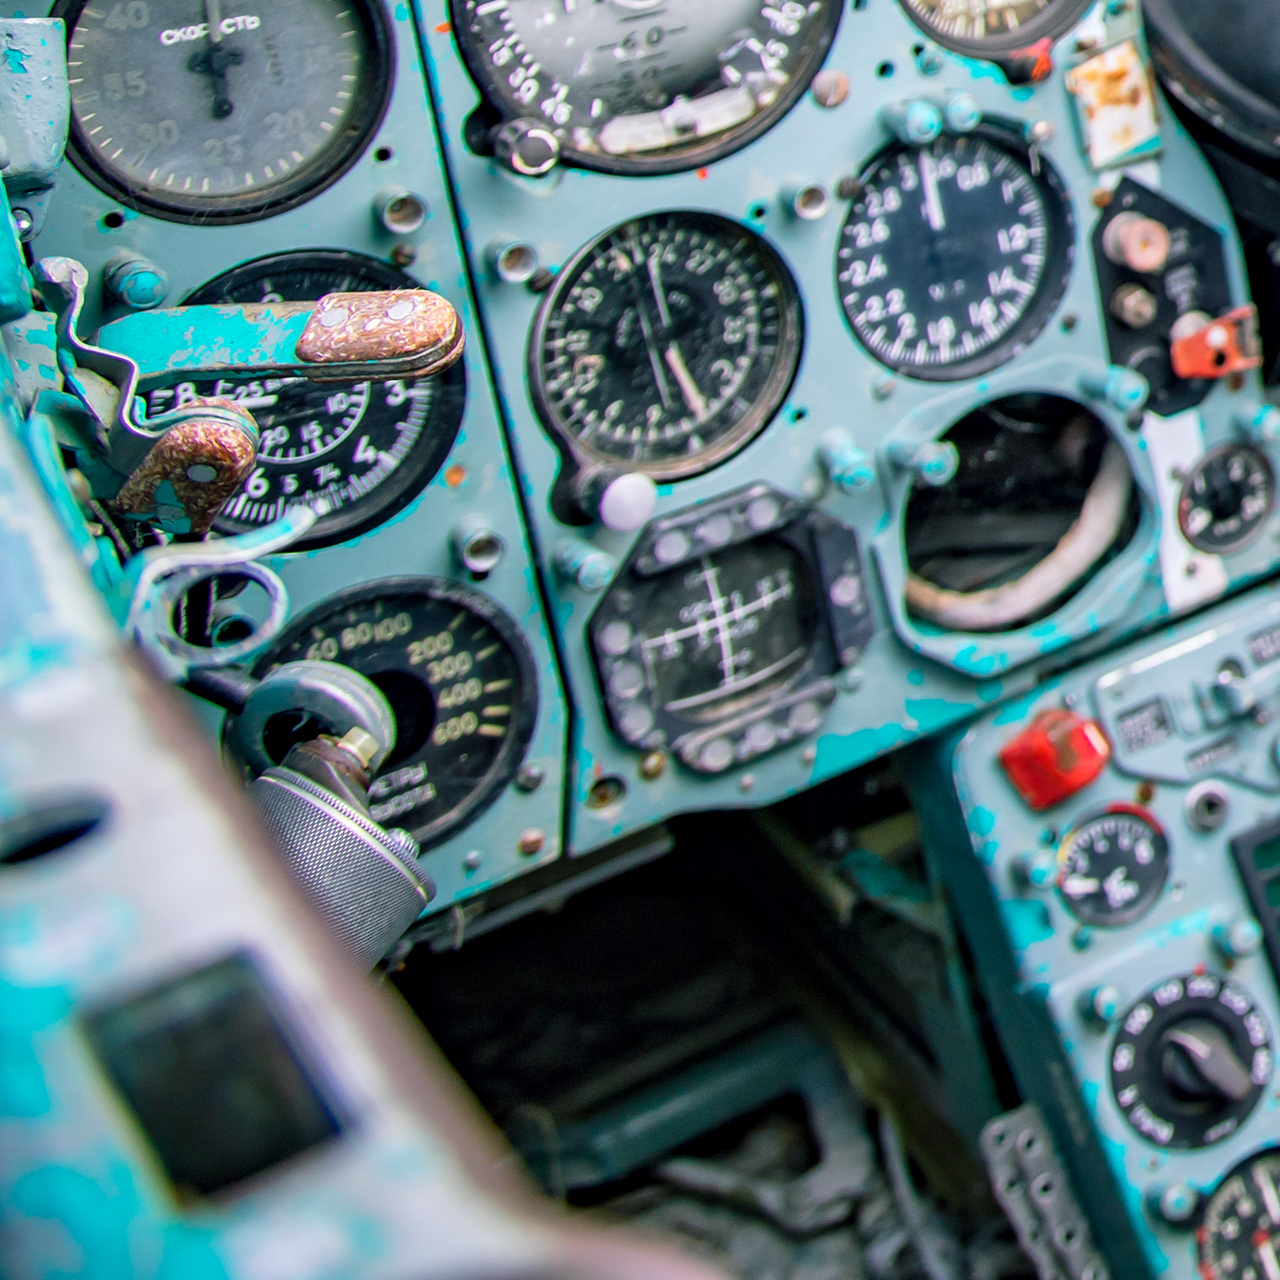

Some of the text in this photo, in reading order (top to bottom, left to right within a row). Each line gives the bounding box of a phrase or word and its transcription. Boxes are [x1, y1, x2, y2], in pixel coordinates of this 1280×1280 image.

[325, 393, 349, 415] 10
[353, 434, 379, 464] 4
[245, 467, 270, 499] 6
[374, 612, 413, 643] 100
[407, 631, 454, 665] 200
[426, 651, 473, 685] 300
[437, 678, 483, 708] 400
[432, 711, 478, 746] 600
